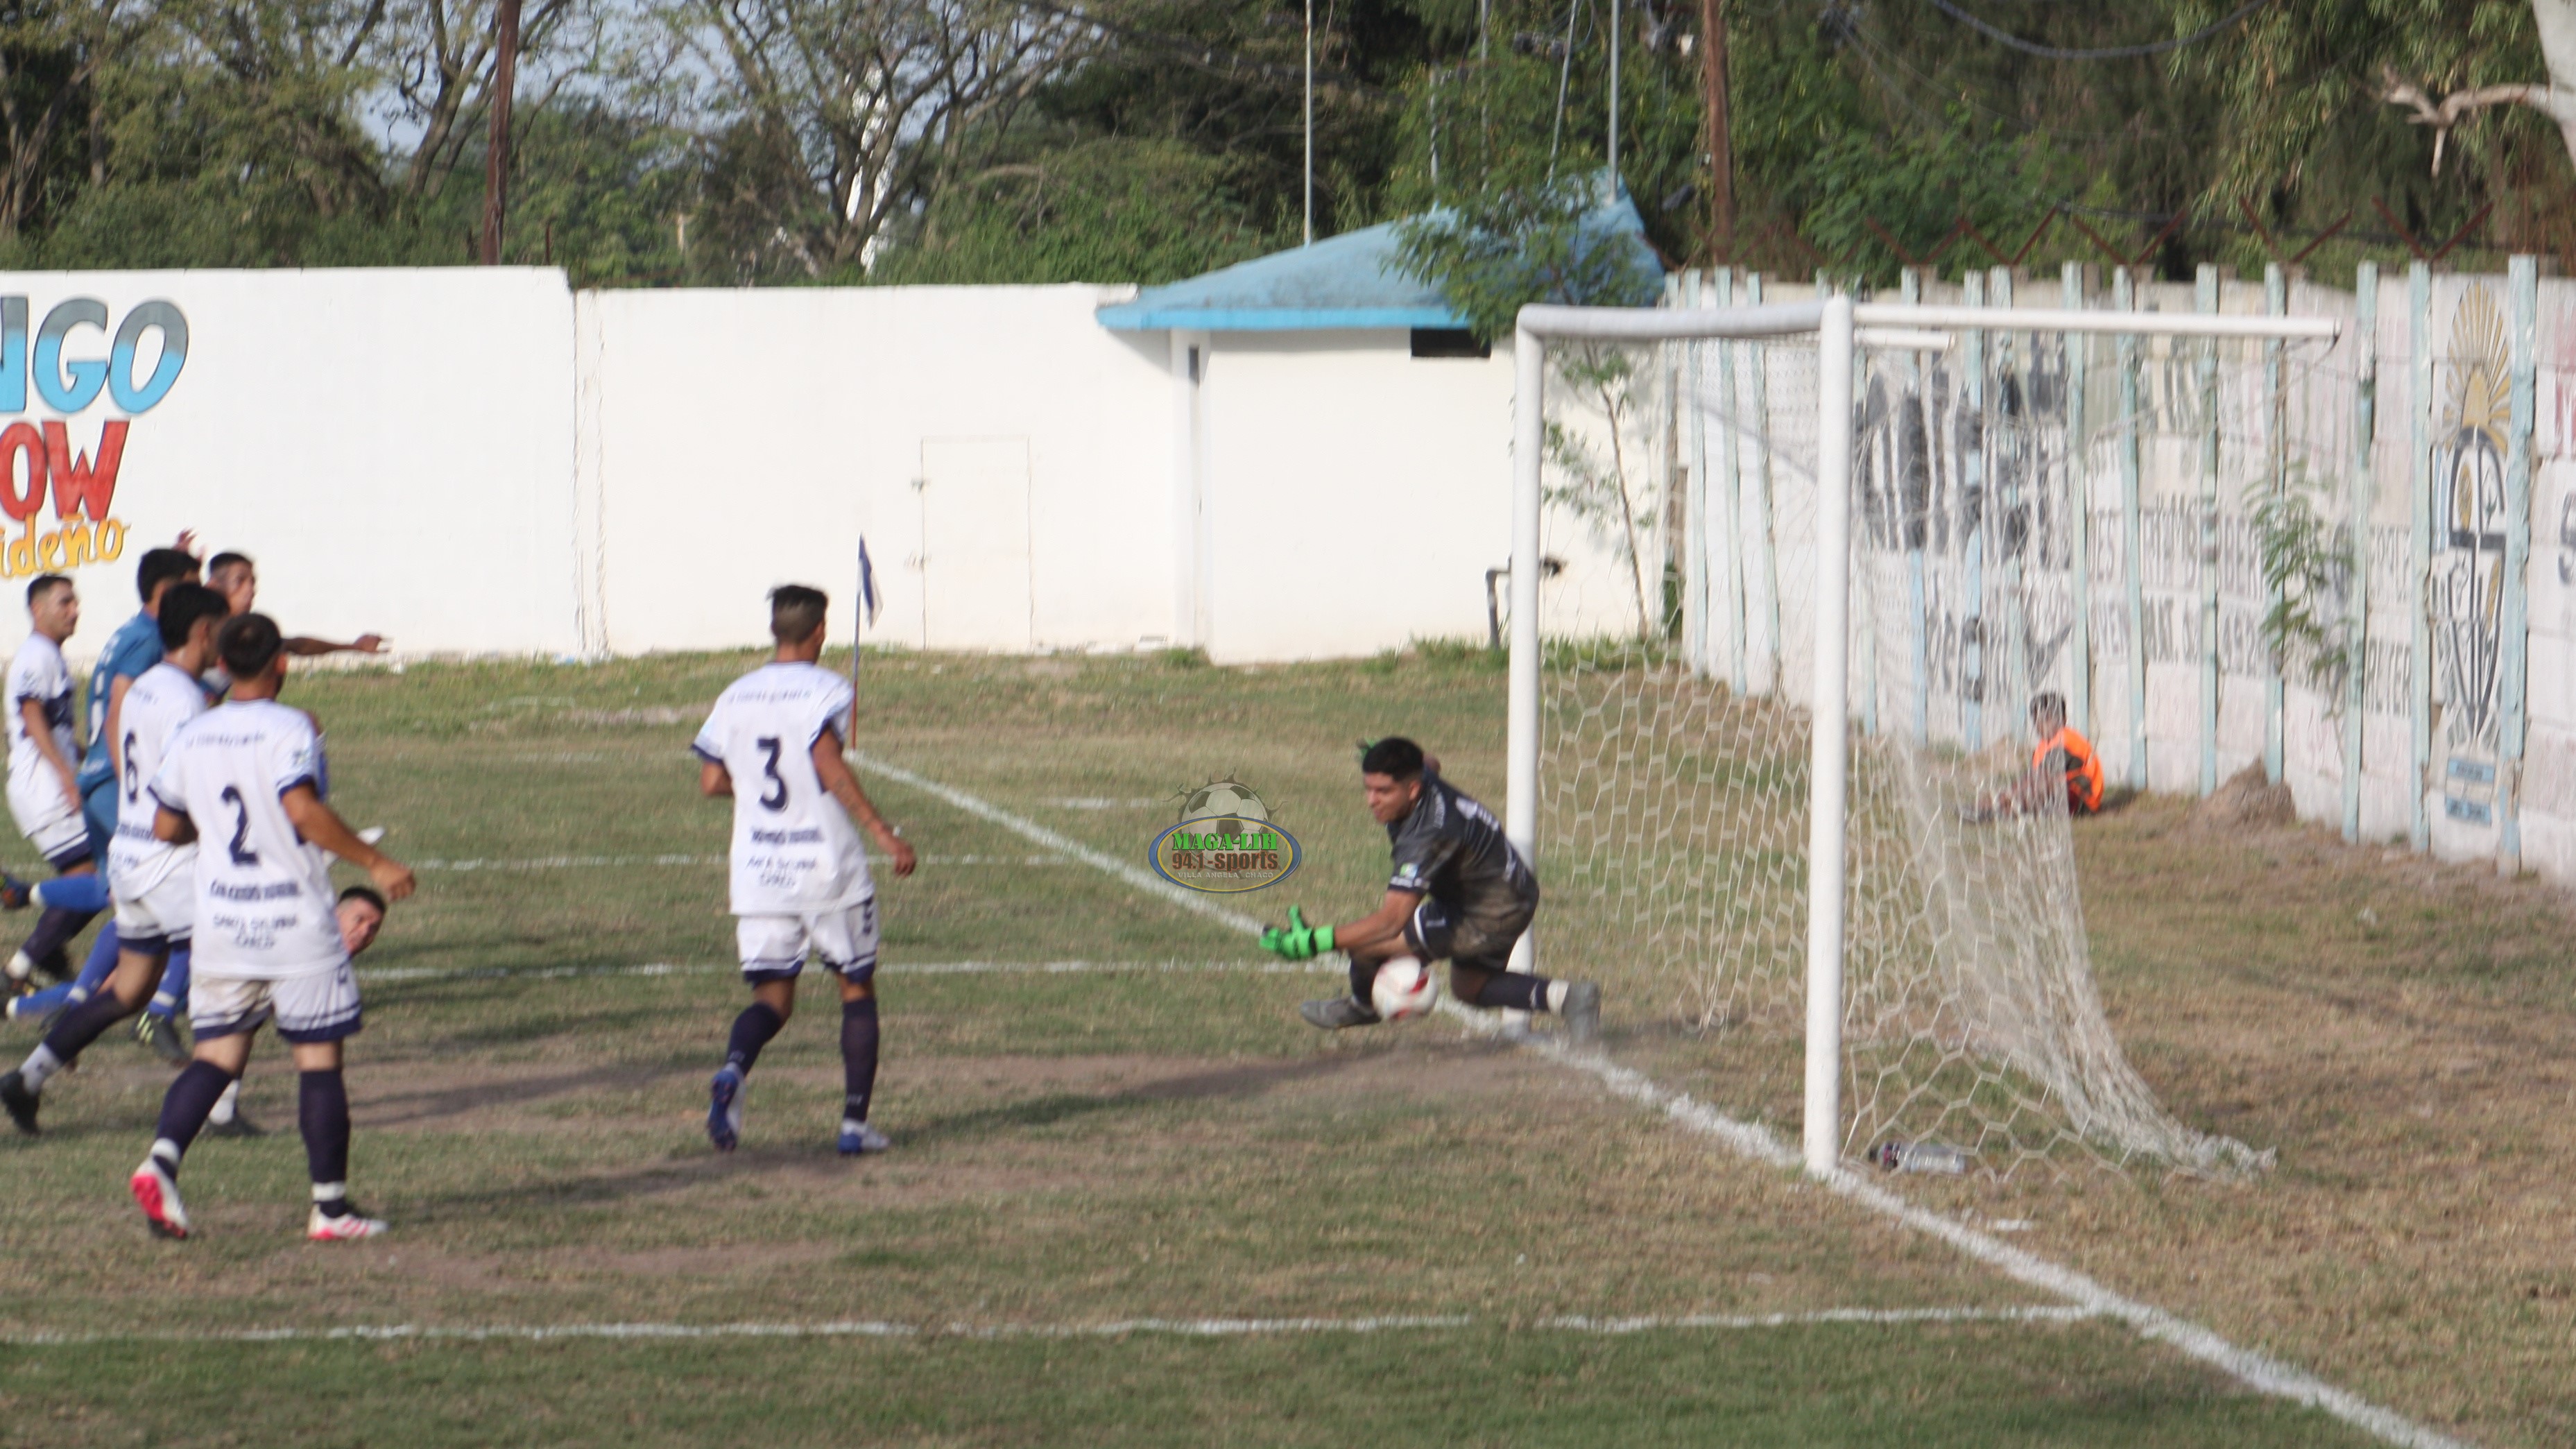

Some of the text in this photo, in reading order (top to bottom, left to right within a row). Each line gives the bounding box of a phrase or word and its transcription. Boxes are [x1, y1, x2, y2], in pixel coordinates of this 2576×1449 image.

[123, 730, 139, 805] 6
[757, 737, 789, 811] 3
[221, 785, 257, 866] 2
